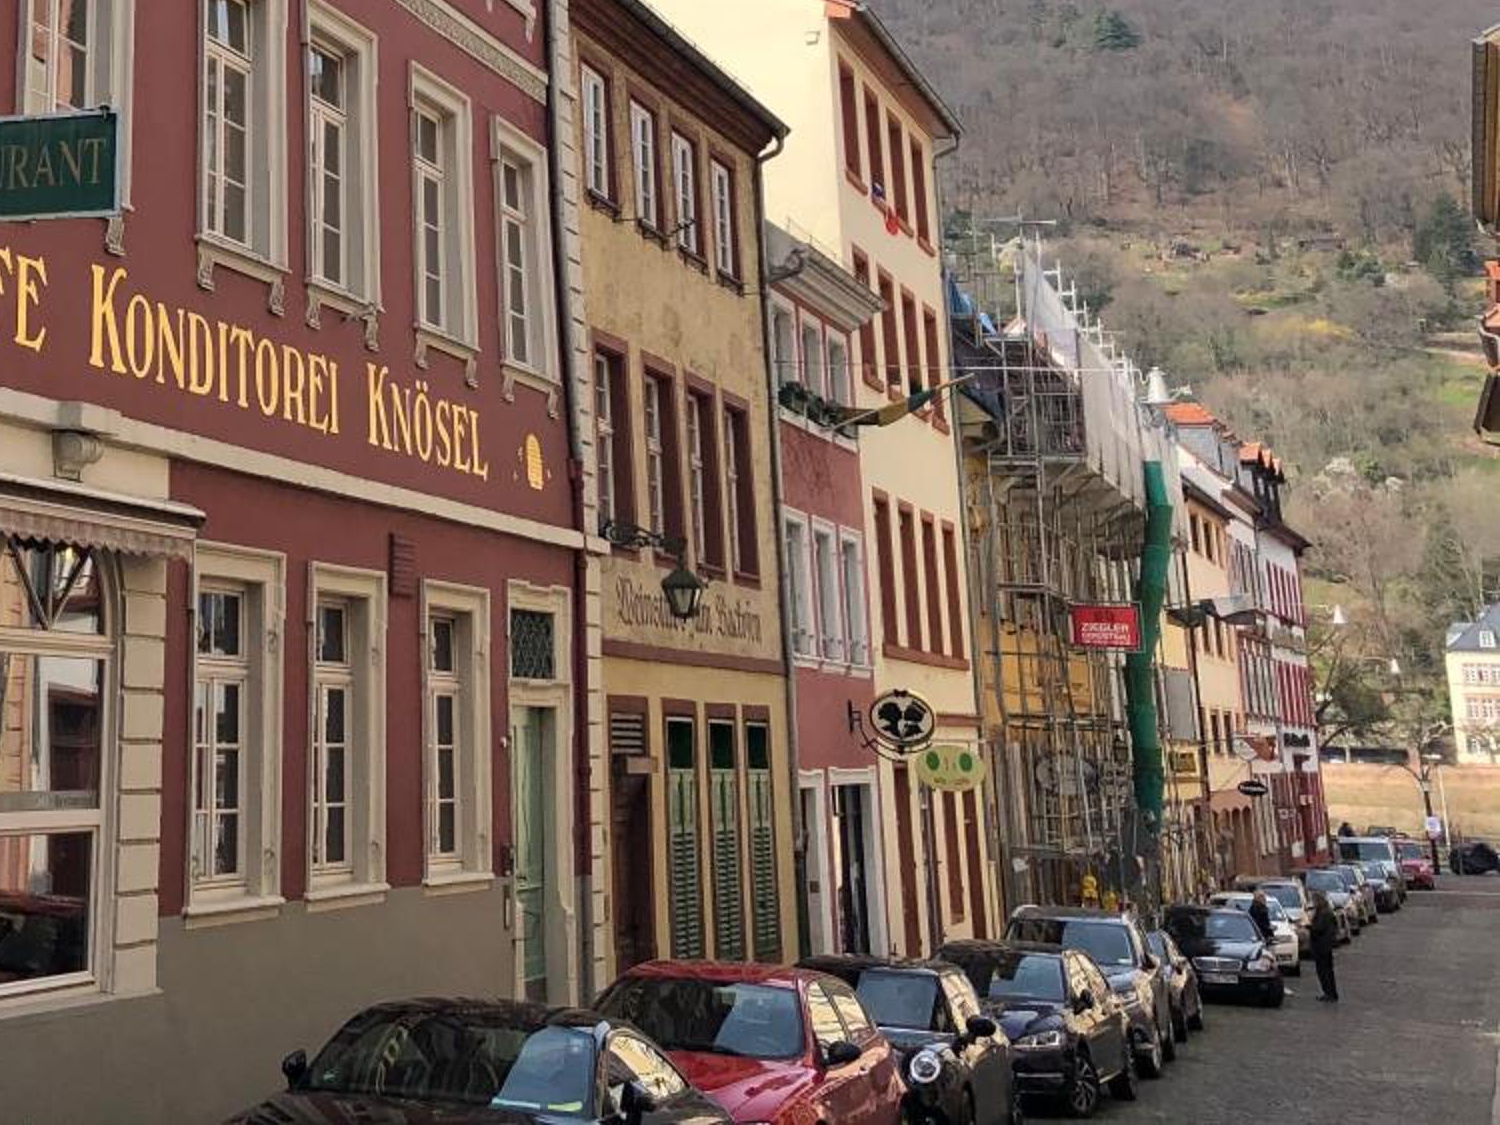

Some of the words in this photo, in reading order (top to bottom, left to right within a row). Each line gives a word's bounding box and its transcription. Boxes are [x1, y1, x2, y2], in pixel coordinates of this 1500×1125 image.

[89, 263, 340, 436] KONDITOREI
[366, 362, 488, 482] KNÖSEL
[1081, 622, 1129, 633] ZIEGLER
